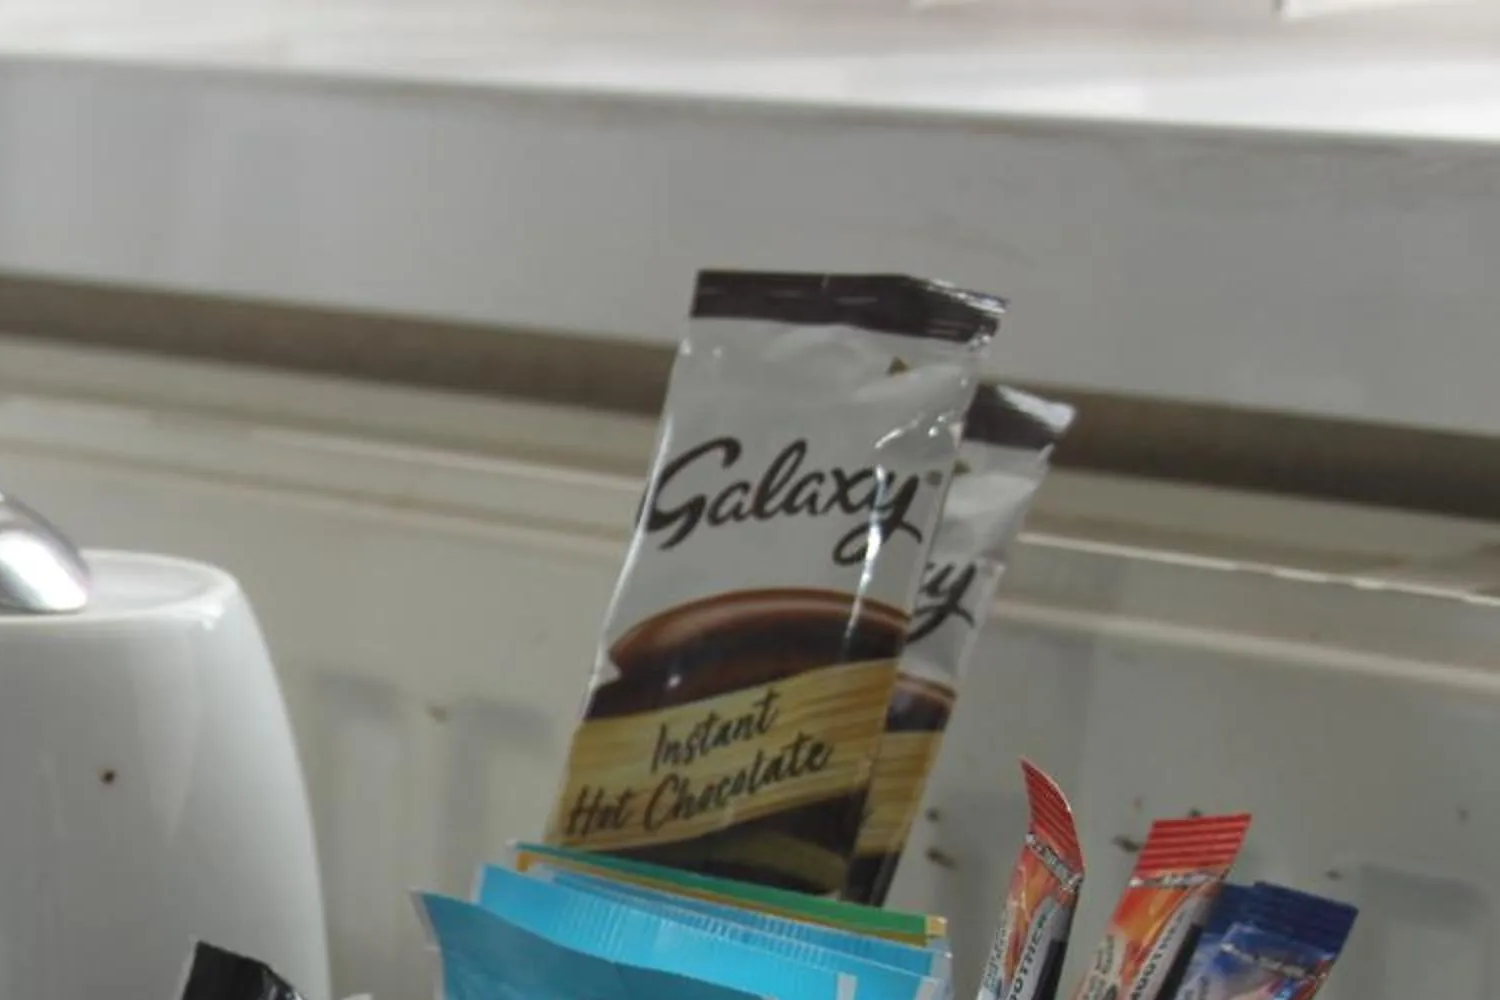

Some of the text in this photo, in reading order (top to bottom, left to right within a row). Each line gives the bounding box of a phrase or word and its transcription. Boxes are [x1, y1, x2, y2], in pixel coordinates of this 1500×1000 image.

[640, 436, 922, 566] Galaxy
[652, 688, 781, 773] Instant
[566, 731, 836, 839] Hot Chocolate
